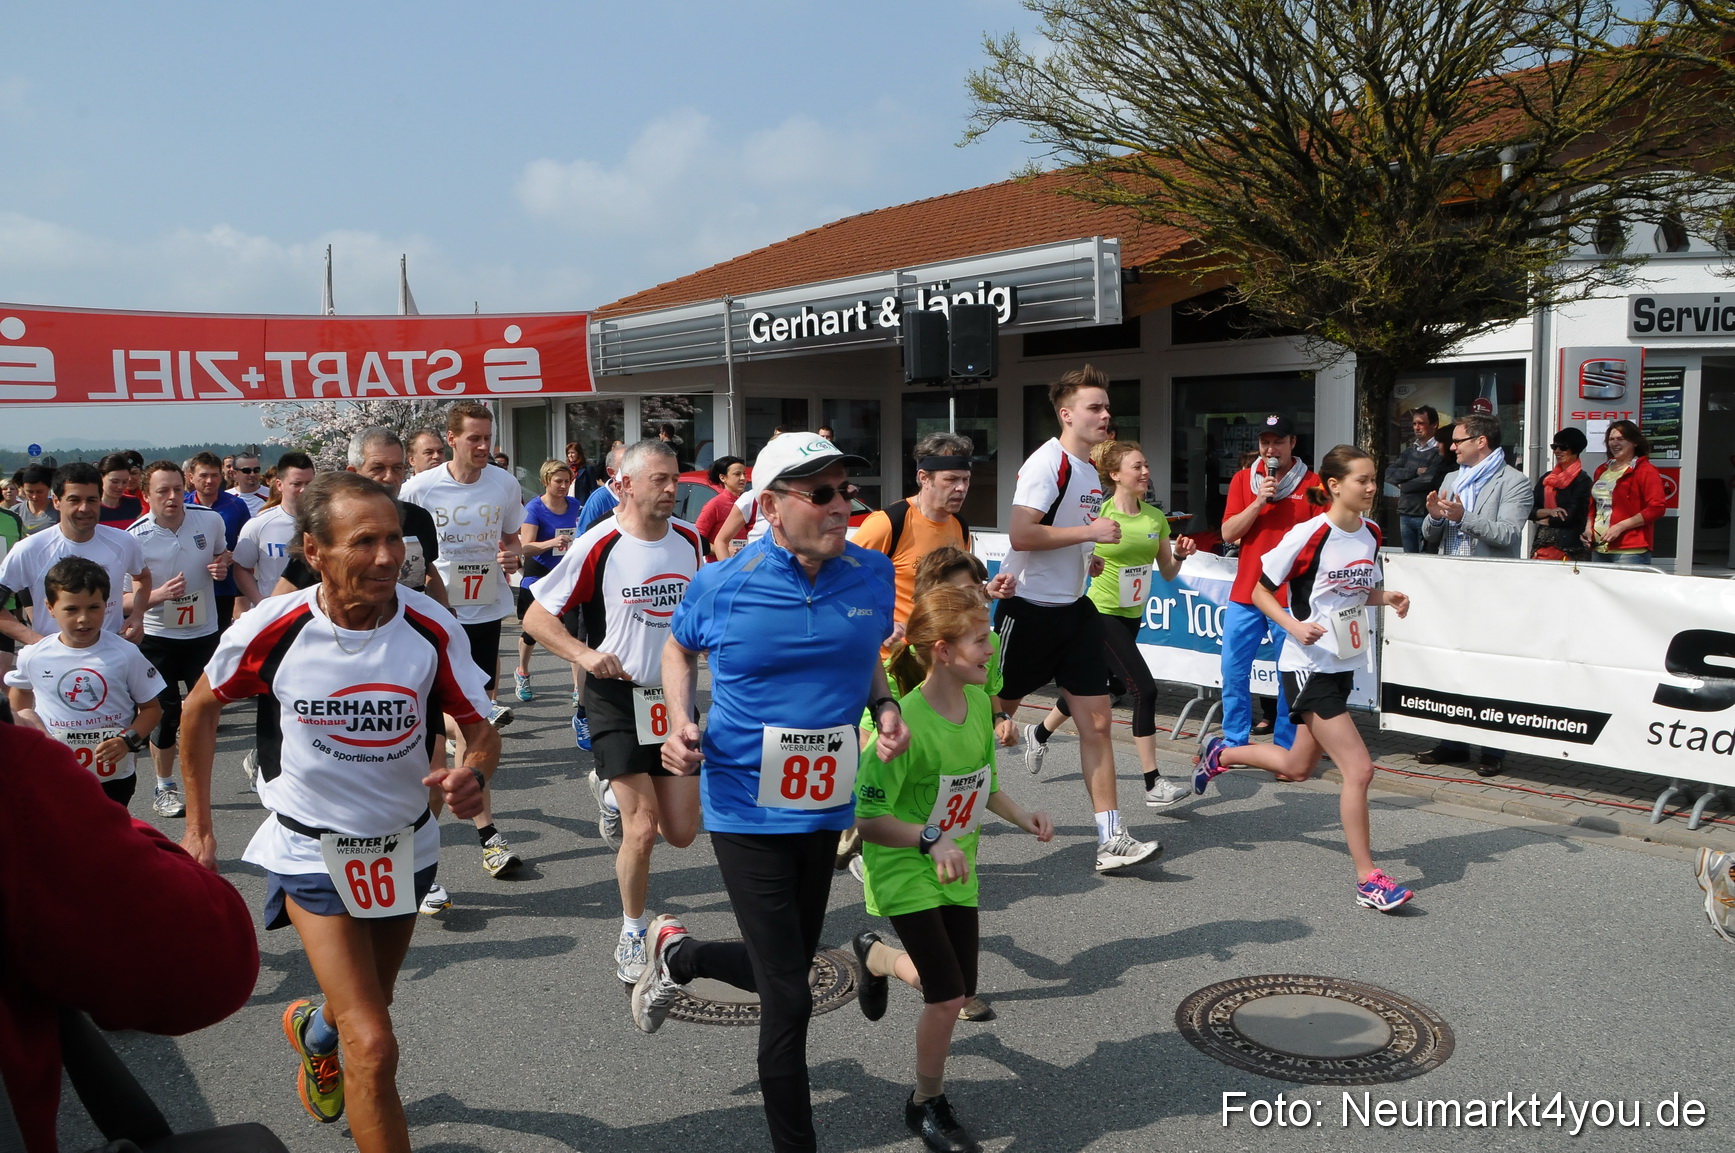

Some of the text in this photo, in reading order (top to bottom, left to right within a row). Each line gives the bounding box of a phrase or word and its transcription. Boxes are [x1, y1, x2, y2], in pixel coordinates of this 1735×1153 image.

[750, 301, 867, 343] Gerhart
[879, 296, 900, 327] &
[1634, 297, 1735, 333] Servic
[1571, 411, 1633, 420] SEAT
[1327, 569, 1373, 579] GERHART
[463, 575, 483, 600] 17
[622, 582, 684, 598] GERHART
[1133, 579, 1142, 601] 2
[652, 594, 686, 607] JÄNI
[177, 605, 194, 625] 71
[632, 613, 644, 623] Das
[1140, 596, 1177, 630] er
[1339, 607, 1357, 617] MEYER
[1349, 620, 1361, 649] 8
[1248, 665, 1276, 683] ier
[644, 688, 664, 696] MEY
[293, 699, 407, 716] GERHART
[1401, 695, 1588, 735] Leistungen, die verbinden
[50, 718, 82, 727] LAUFEN
[86, 716, 102, 726] MIT
[297, 714, 416, 732] Autohaus JÄNIG
[67, 732, 100, 740] MEYER
[780, 733, 825, 744] MEYER
[1647, 719, 1735, 756] stad
[312, 733, 422, 763] Das sportliche Autohaus
[780, 744, 825, 752] WERBUNG
[780, 755, 837, 801] 83
[950, 776, 976, 787] MEYER
[950, 783, 976, 793] WERBUNG
[939, 791, 978, 832] 34
[336, 846, 381, 854] WERBUNG
[337, 837, 382, 847] MEYER
[345, 857, 396, 910] 66
